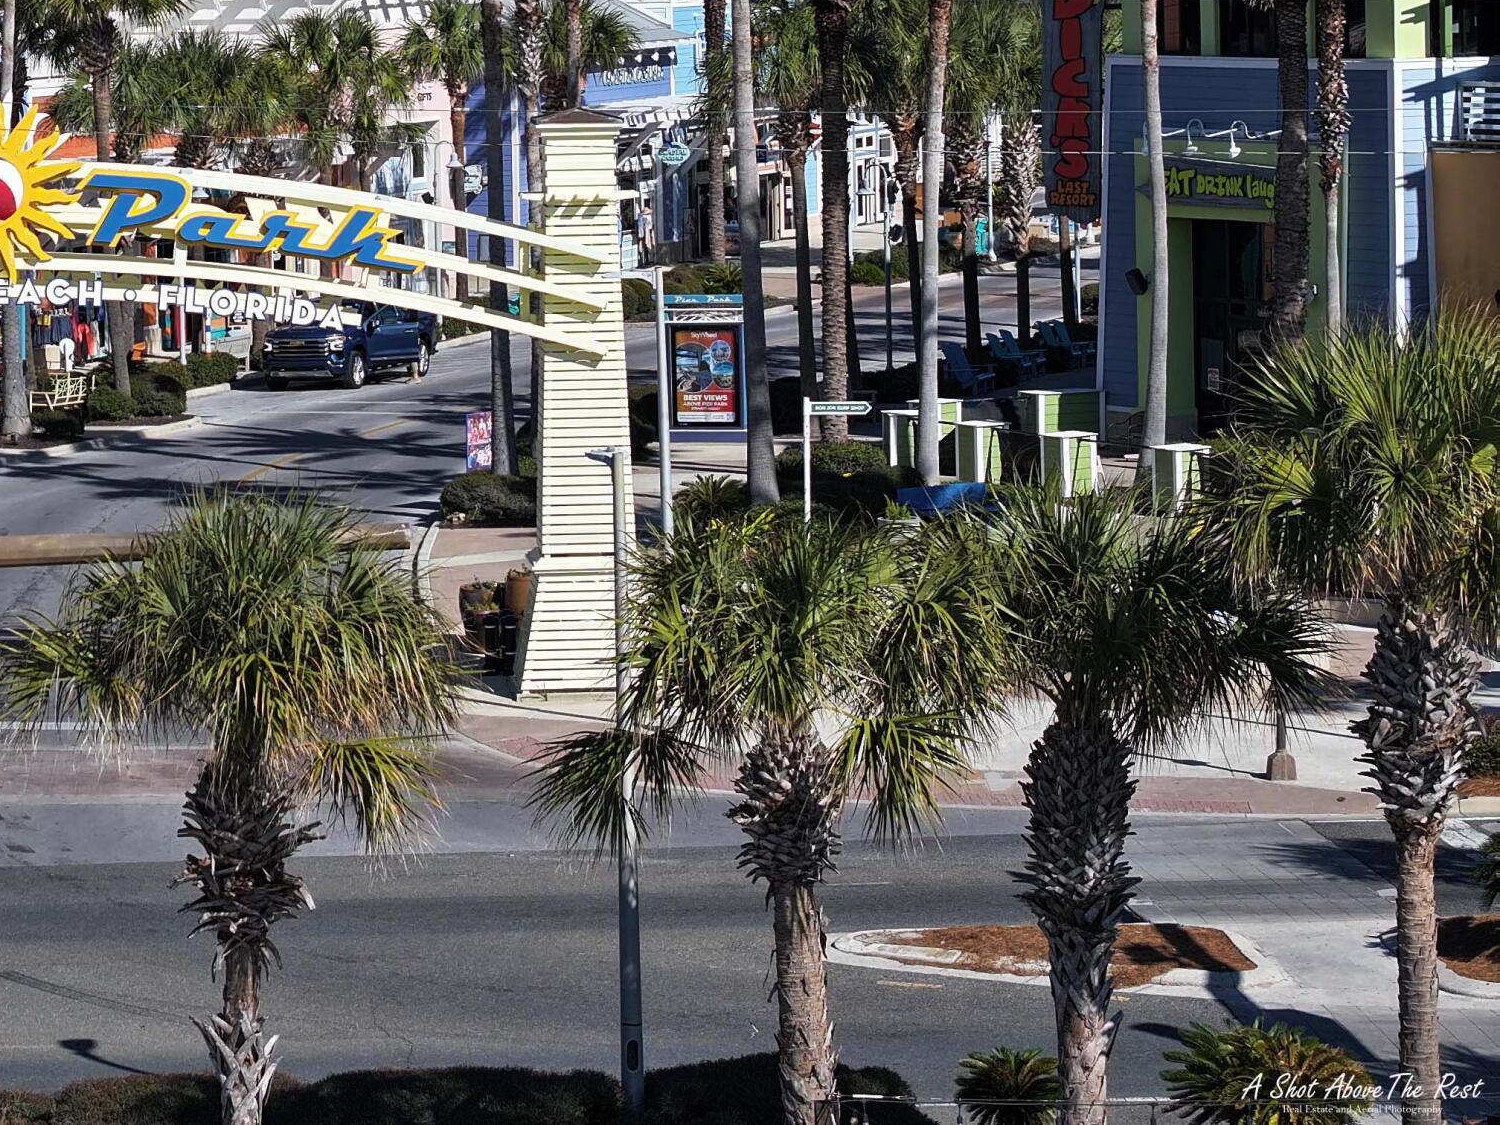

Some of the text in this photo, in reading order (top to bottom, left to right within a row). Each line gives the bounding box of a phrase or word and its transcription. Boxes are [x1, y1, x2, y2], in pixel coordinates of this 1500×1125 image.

[1050, 192, 1096, 206] RESORT
[1057, 180, 1090, 194] LAST
[1196, 174, 1243, 197] DRINK
[1246, 174, 1277, 209] laug
[76, 169, 426, 275] Park
[158, 283, 344, 333] FLORIDA
